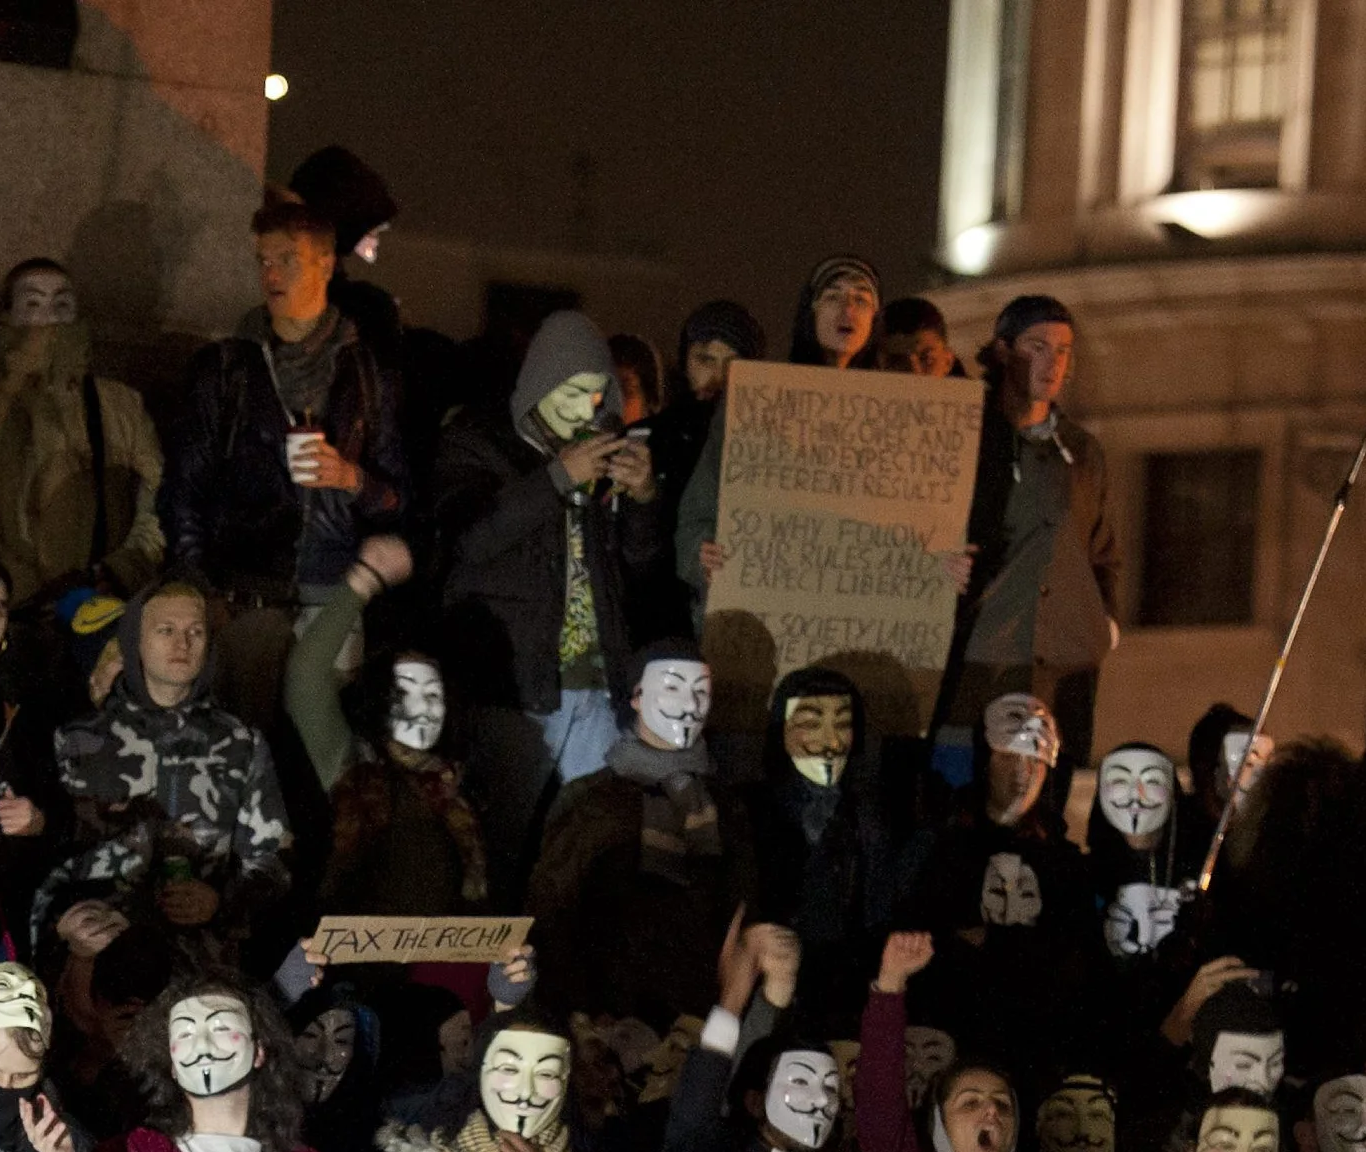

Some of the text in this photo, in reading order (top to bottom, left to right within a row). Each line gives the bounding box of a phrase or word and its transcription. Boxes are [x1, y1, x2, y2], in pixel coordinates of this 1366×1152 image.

[725, 461, 857, 497] DIFFERENT
[770, 514, 823, 544] WHY
[801, 544, 871, 571] RULES
[741, 564, 824, 593] EXPECT
[322, 928, 385, 955] TAX
[392, 928, 438, 950] THE
